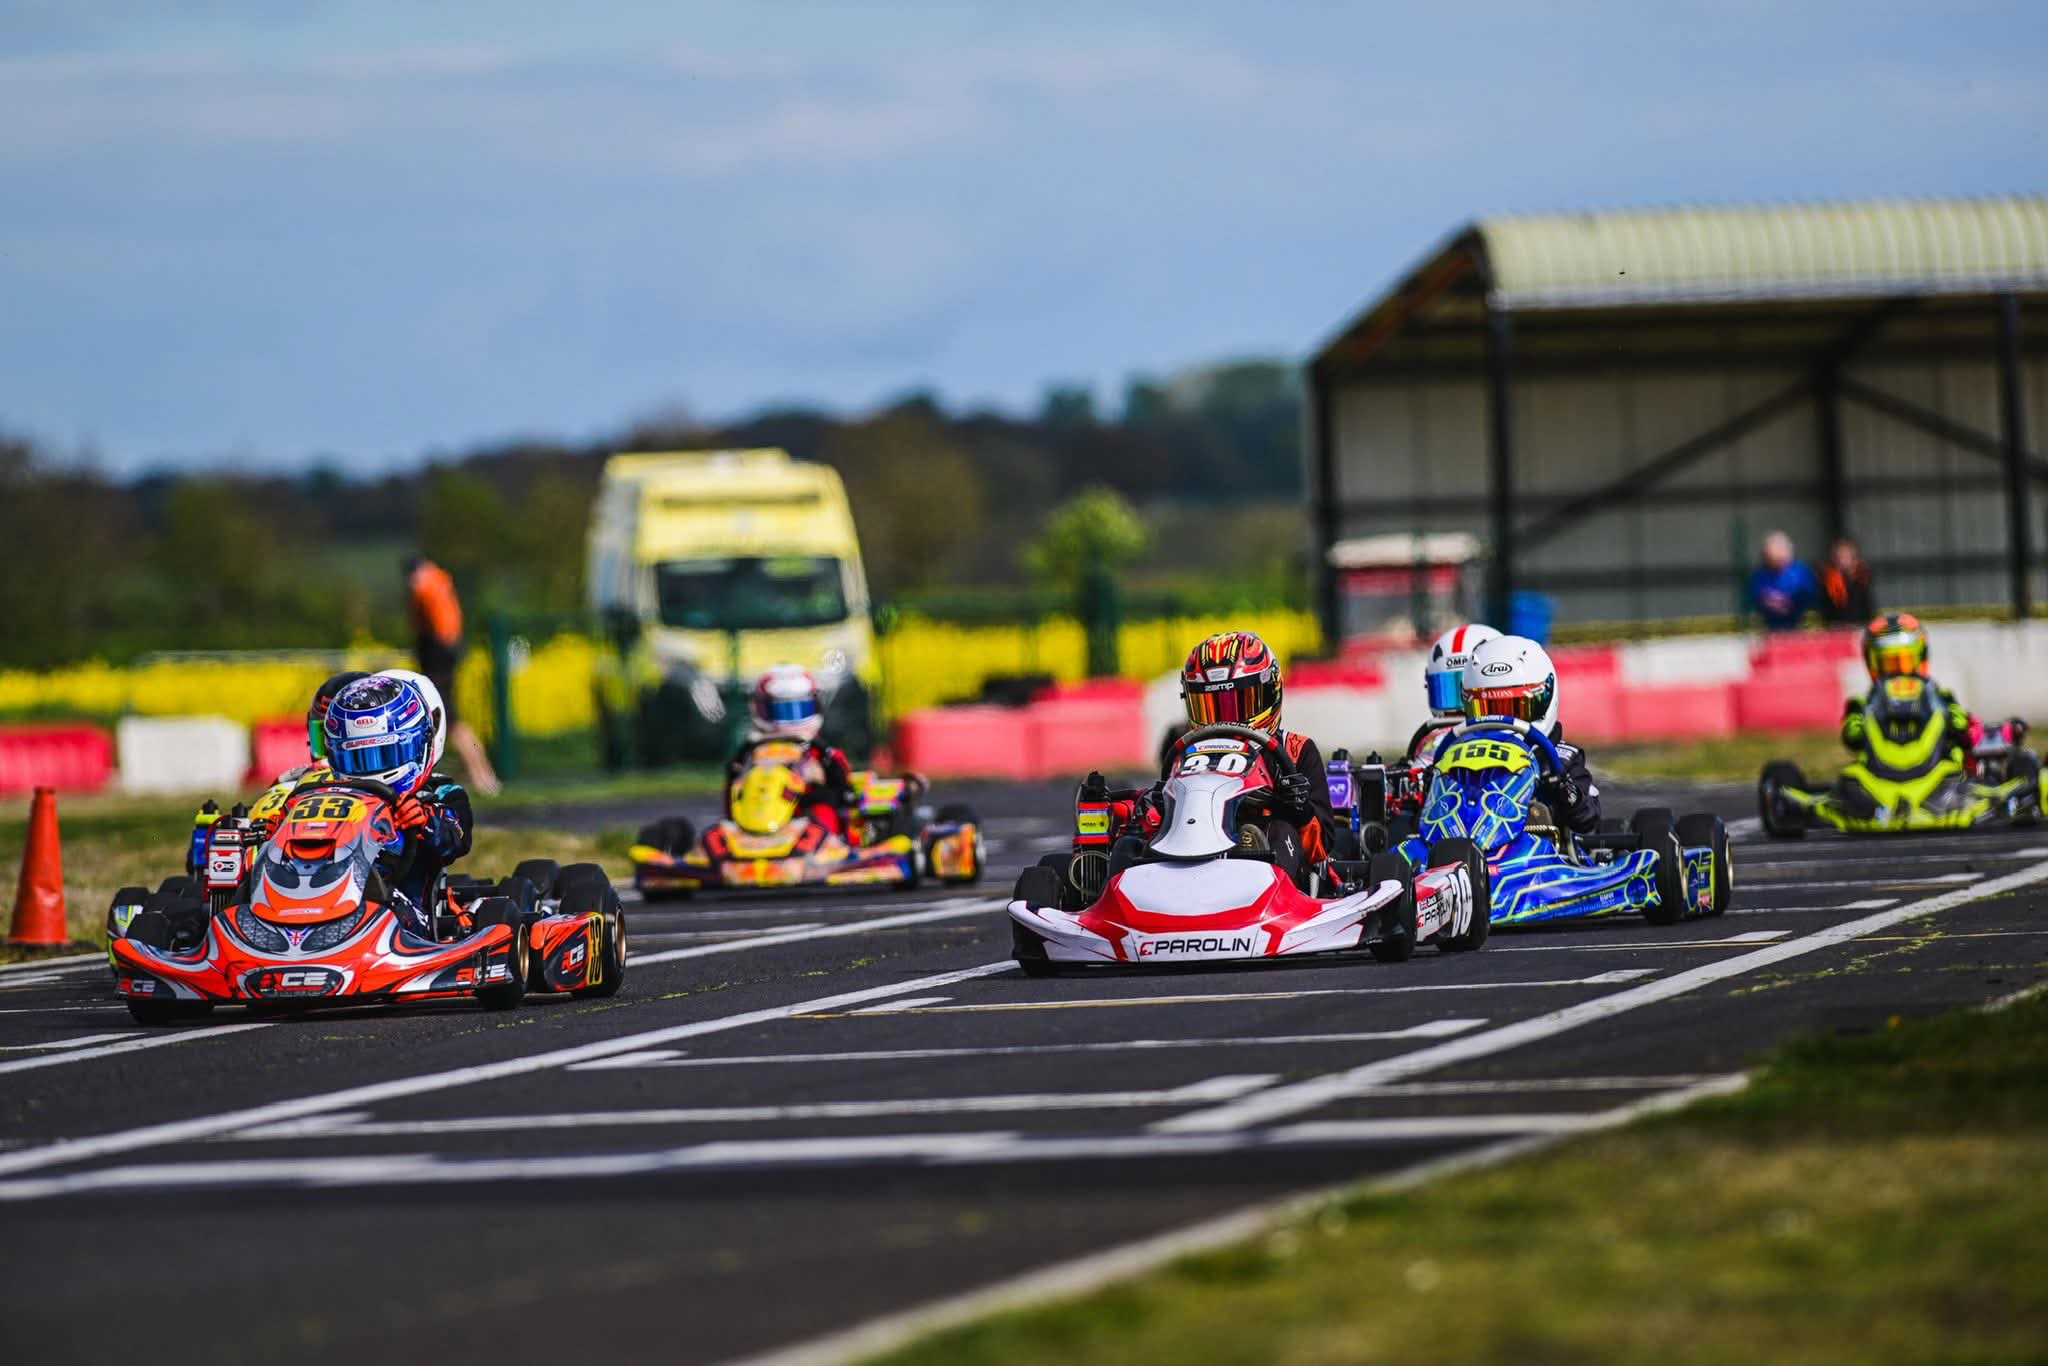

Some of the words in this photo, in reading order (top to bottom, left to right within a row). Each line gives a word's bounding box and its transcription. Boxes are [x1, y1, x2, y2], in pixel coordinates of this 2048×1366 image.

[1446, 658, 1468, 667] OMP
[1489, 662, 1508, 673] Arai
[1205, 682, 1234, 691] zamp
[1488, 690, 1513, 699] LYONS
[1452, 743, 1510, 762] 155
[1181, 753, 1247, 775] 30
[292, 798, 355, 819] 33
